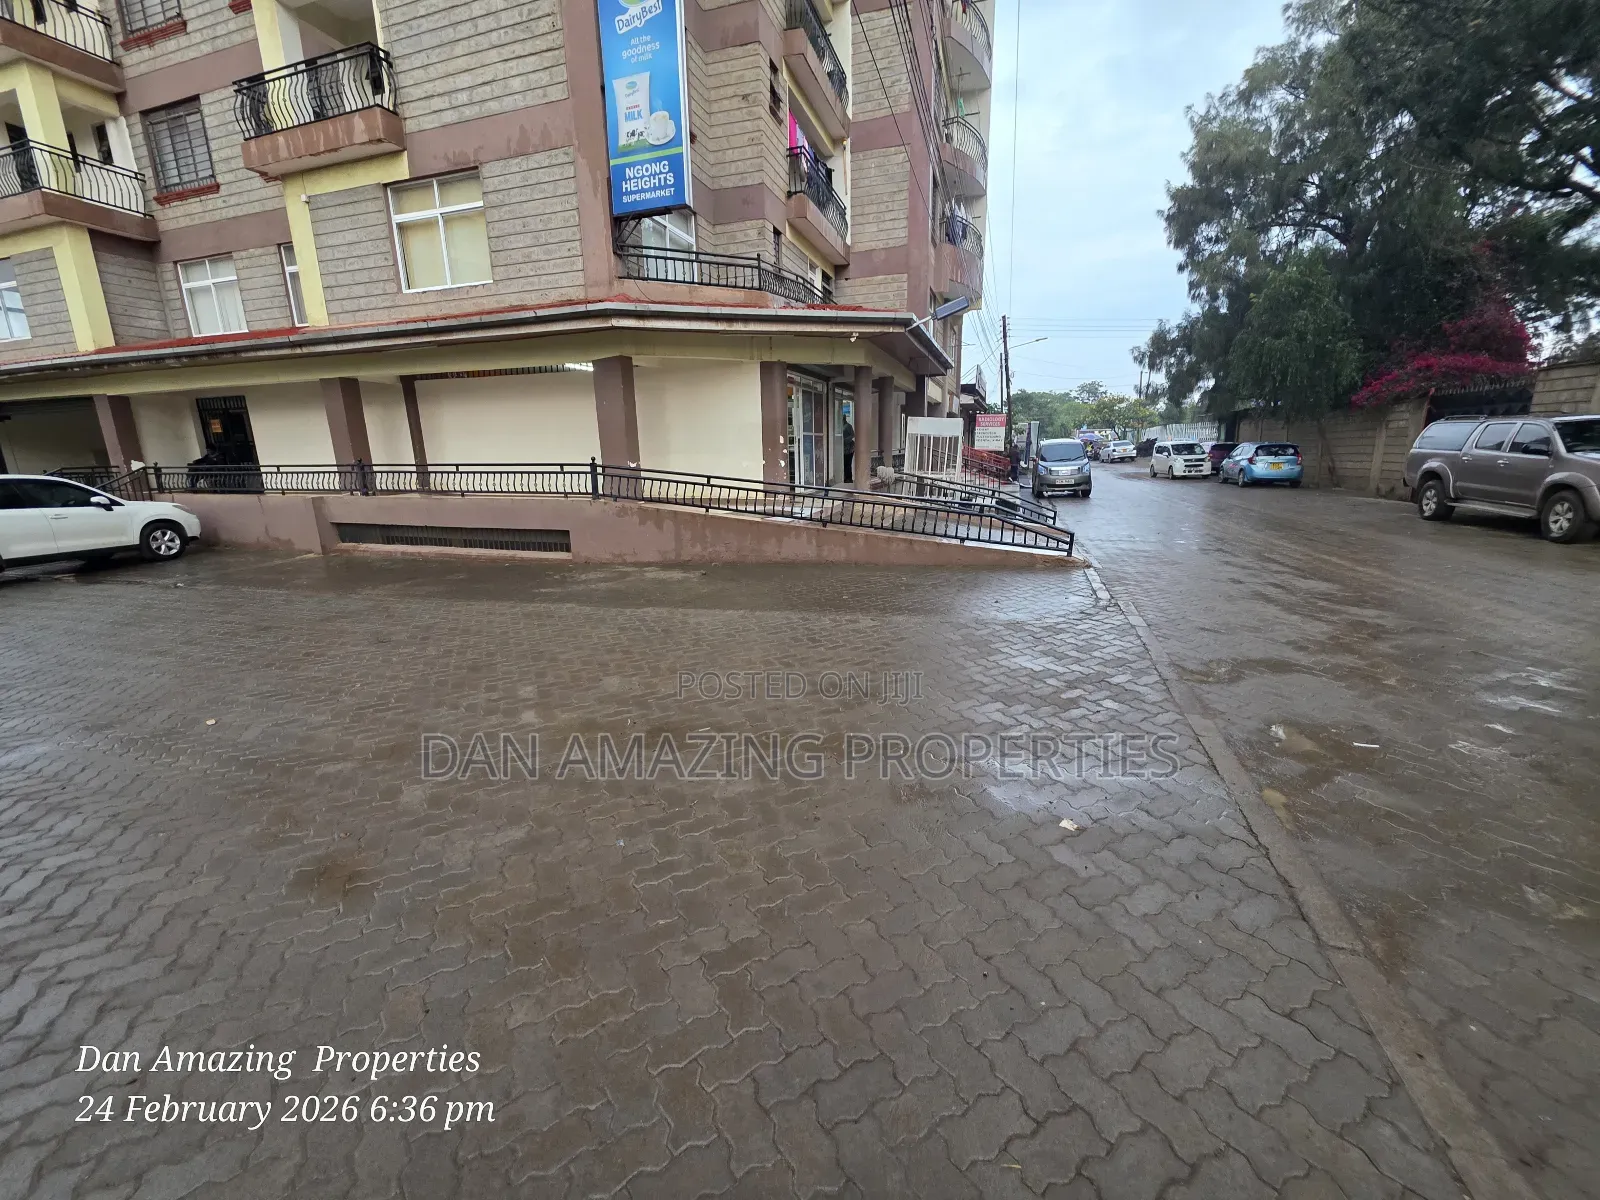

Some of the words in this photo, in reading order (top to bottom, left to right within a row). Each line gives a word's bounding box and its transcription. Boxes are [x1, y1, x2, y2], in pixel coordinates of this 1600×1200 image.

[616, 0, 661, 31] DairyBest
[630, 37, 640, 46] All
[640, 34, 651, 44] the
[621, 41, 660, 60] goodness
[638, 52, 653, 62] milk
[624, 109, 643, 123] MILK
[625, 160, 669, 180] NGONG
[622, 172, 675, 193] HEIGHTS
[622, 187, 675, 203] SUPERMARKET
